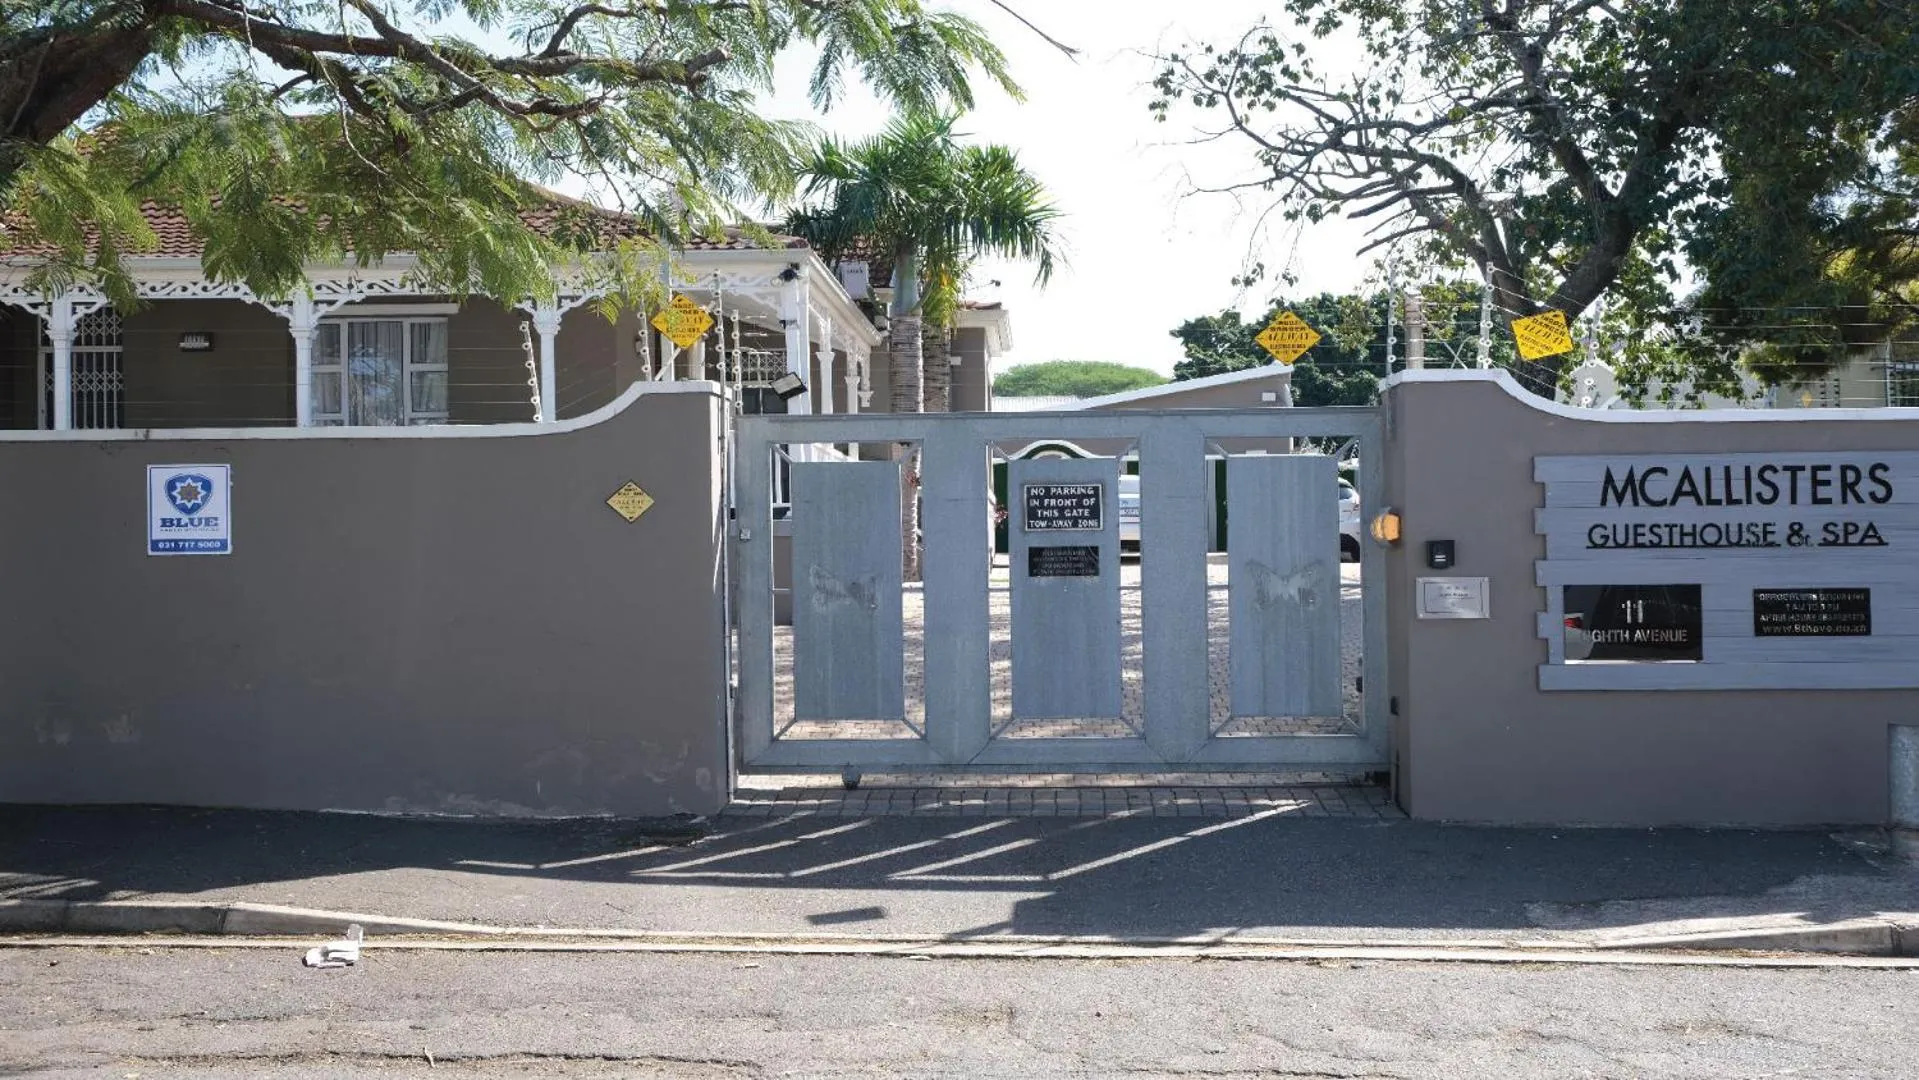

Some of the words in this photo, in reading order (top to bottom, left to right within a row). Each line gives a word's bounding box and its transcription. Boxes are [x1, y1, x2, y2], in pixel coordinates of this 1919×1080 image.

[1600, 463, 1893, 507] MCALLISTERS
[1030, 487, 1045, 495] NO
[1050, 487, 1094, 495] PARKING
[1030, 499, 1039, 507] IN
[1044, 498, 1077, 507] FRONT
[1083, 498, 1096, 506] OF
[1037, 509, 1059, 517] THIS
[1064, 509, 1090, 517] GATE
[160, 517, 219, 528] BLUE
[1029, 520, 1074, 528] TOW-AWAY
[1078, 520, 1098, 528] ZONE
[1587, 522, 1778, 548] GUESTHOUSE
[1820, 521, 1886, 547] SPA
[178, 541, 195, 549] 717
[1621, 599, 1644, 624] 11
[1634, 629, 1688, 642] AVENUE
